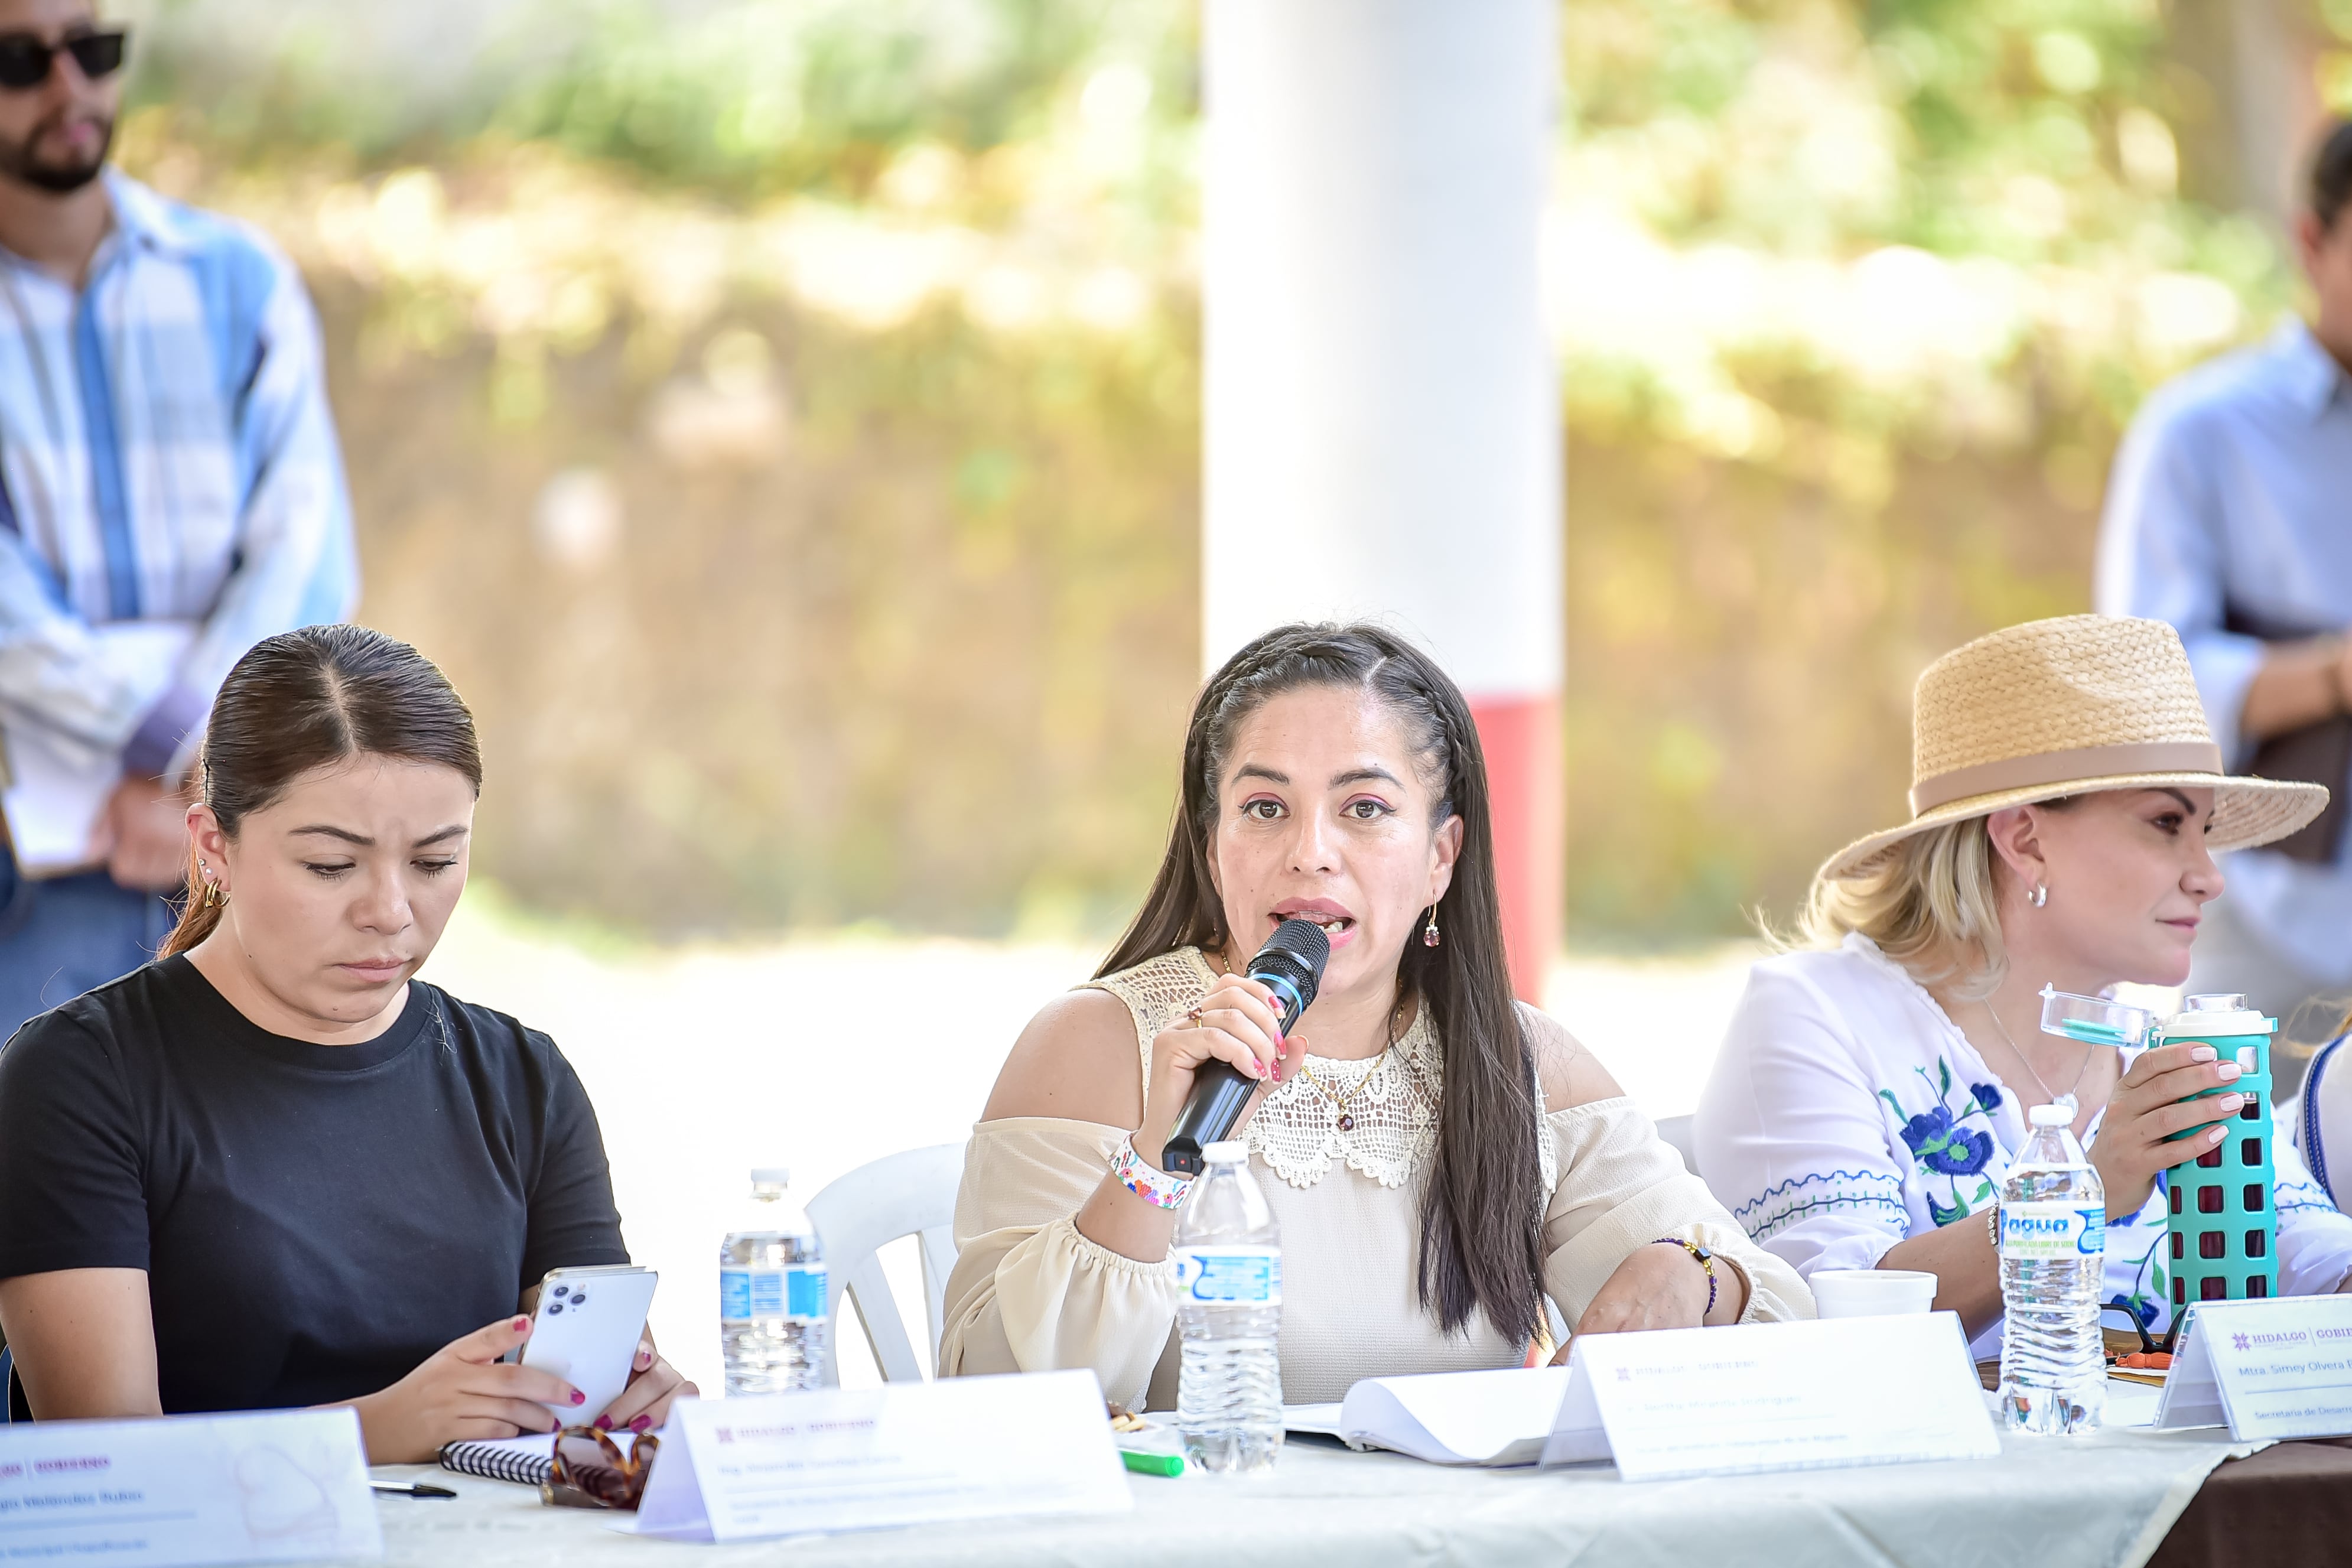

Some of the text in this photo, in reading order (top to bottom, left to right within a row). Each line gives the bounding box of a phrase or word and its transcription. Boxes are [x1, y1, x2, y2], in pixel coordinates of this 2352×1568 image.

[2009, 1218, 2069, 1240] agua
[2252, 1331, 2307, 1343] HIDALGO
[2270, 1364, 2306, 1374] Simey
[2308, 1360, 2344, 1371] Olvera
[2305, 1407, 2315, 1416] de
